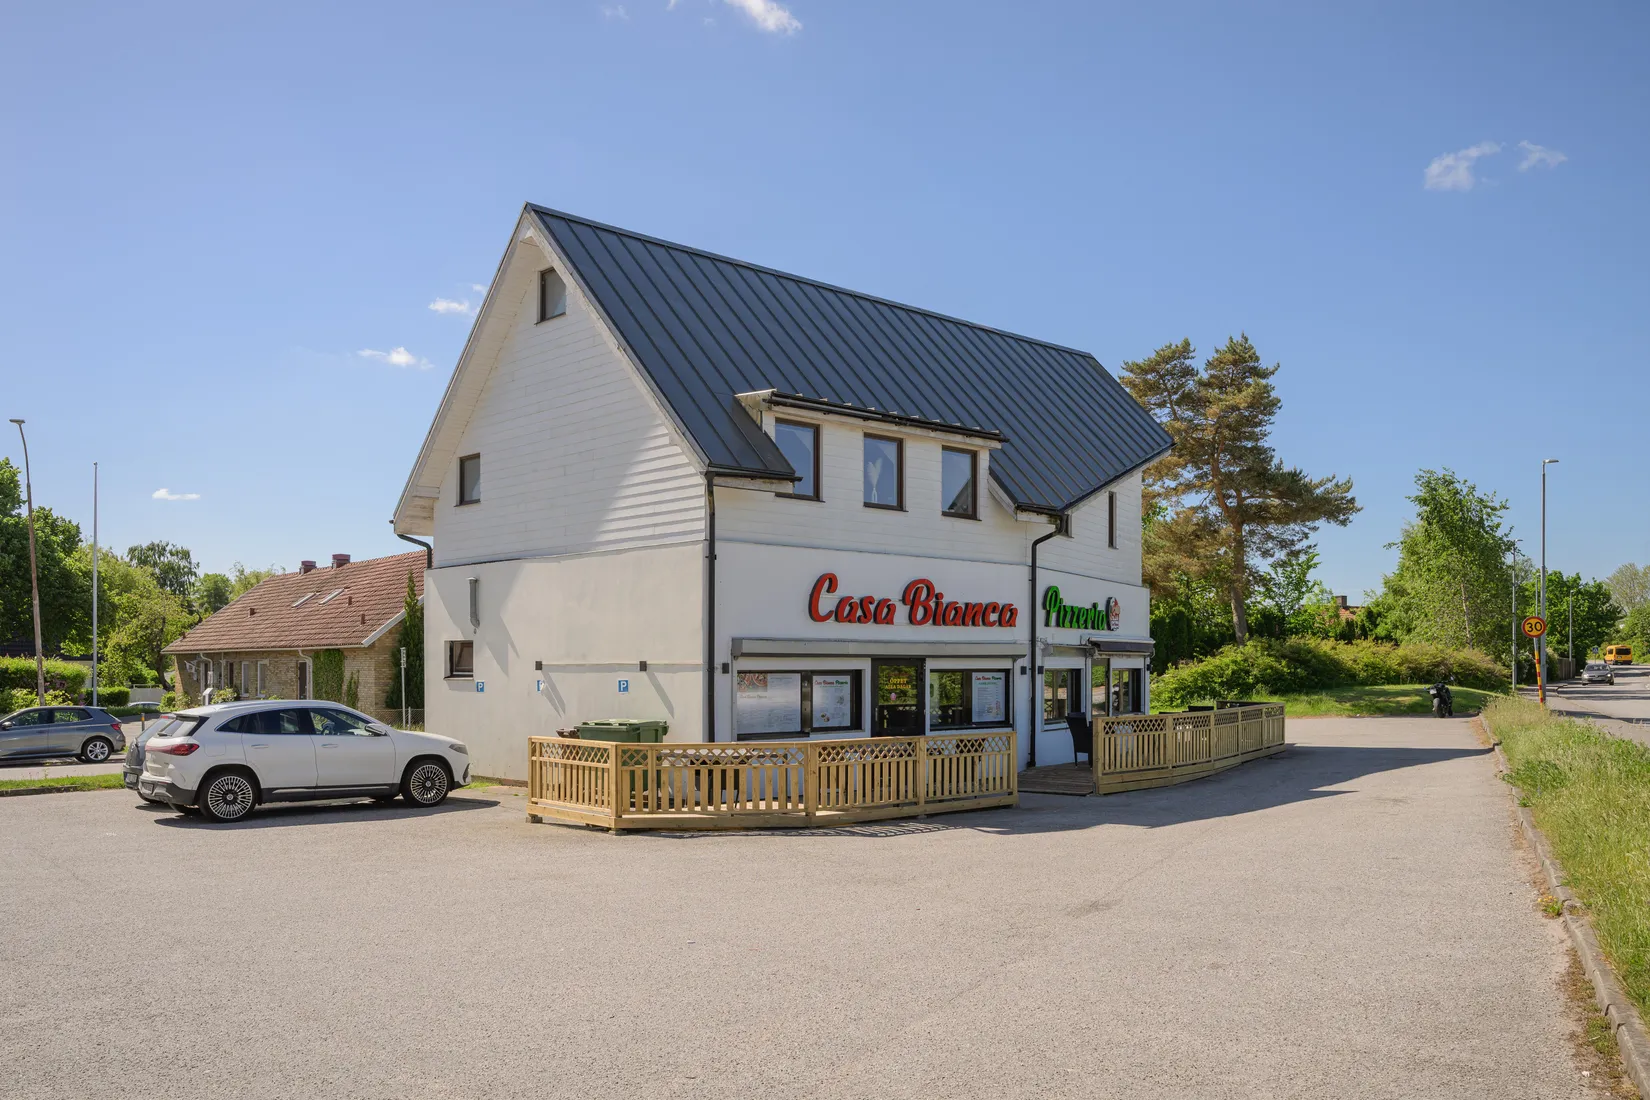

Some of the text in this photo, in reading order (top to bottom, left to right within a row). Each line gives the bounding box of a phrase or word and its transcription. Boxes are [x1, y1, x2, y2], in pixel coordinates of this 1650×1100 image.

[808, 572, 1019, 628] Casa Bianca
[1042, 585, 1107, 631] Pizzeria
[1526, 621, 1543, 633] 30
[620, 681, 627, 691] P
